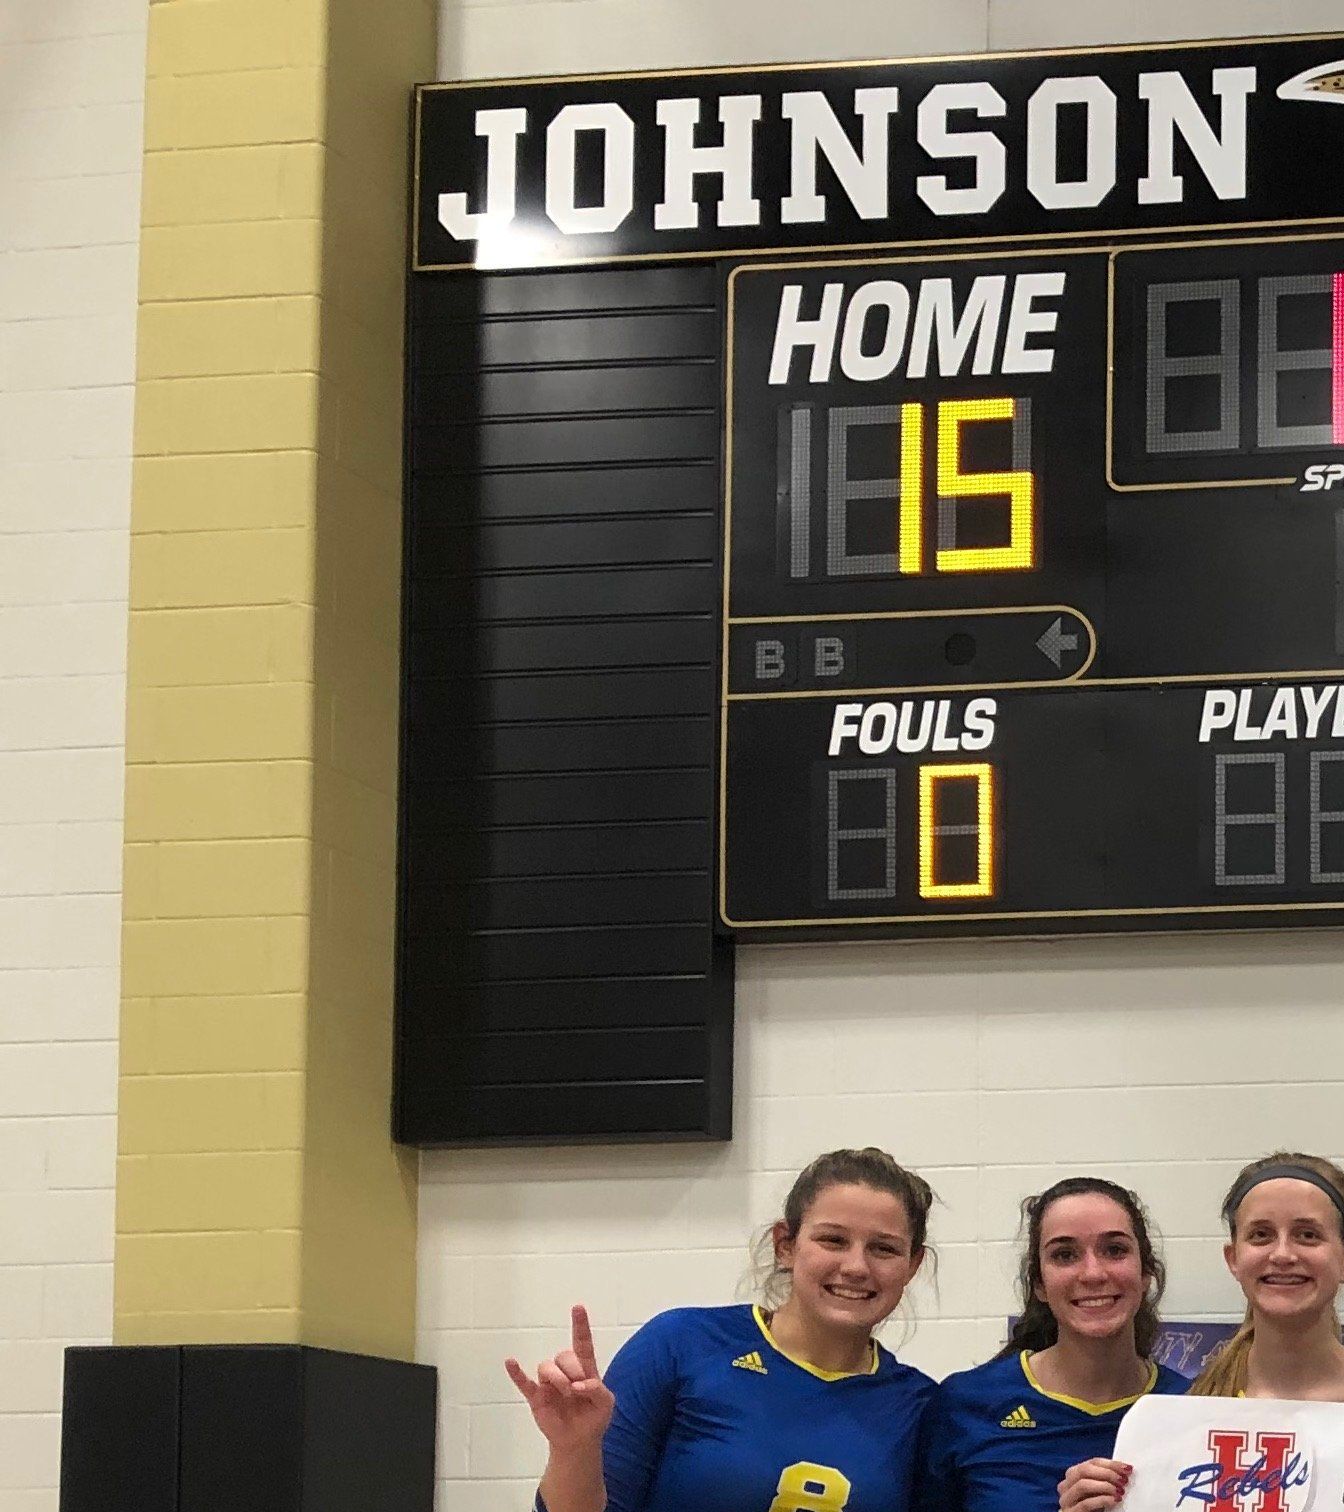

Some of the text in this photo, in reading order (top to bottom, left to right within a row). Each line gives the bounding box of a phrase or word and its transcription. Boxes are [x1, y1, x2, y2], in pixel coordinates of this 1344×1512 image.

[437, 66, 1258, 241] JOHNSON
[768, 272, 1066, 385] HOME
[900, 397, 1033, 574] 15
[828, 697, 996, 756] FOULS
[918, 763, 995, 899] 0
